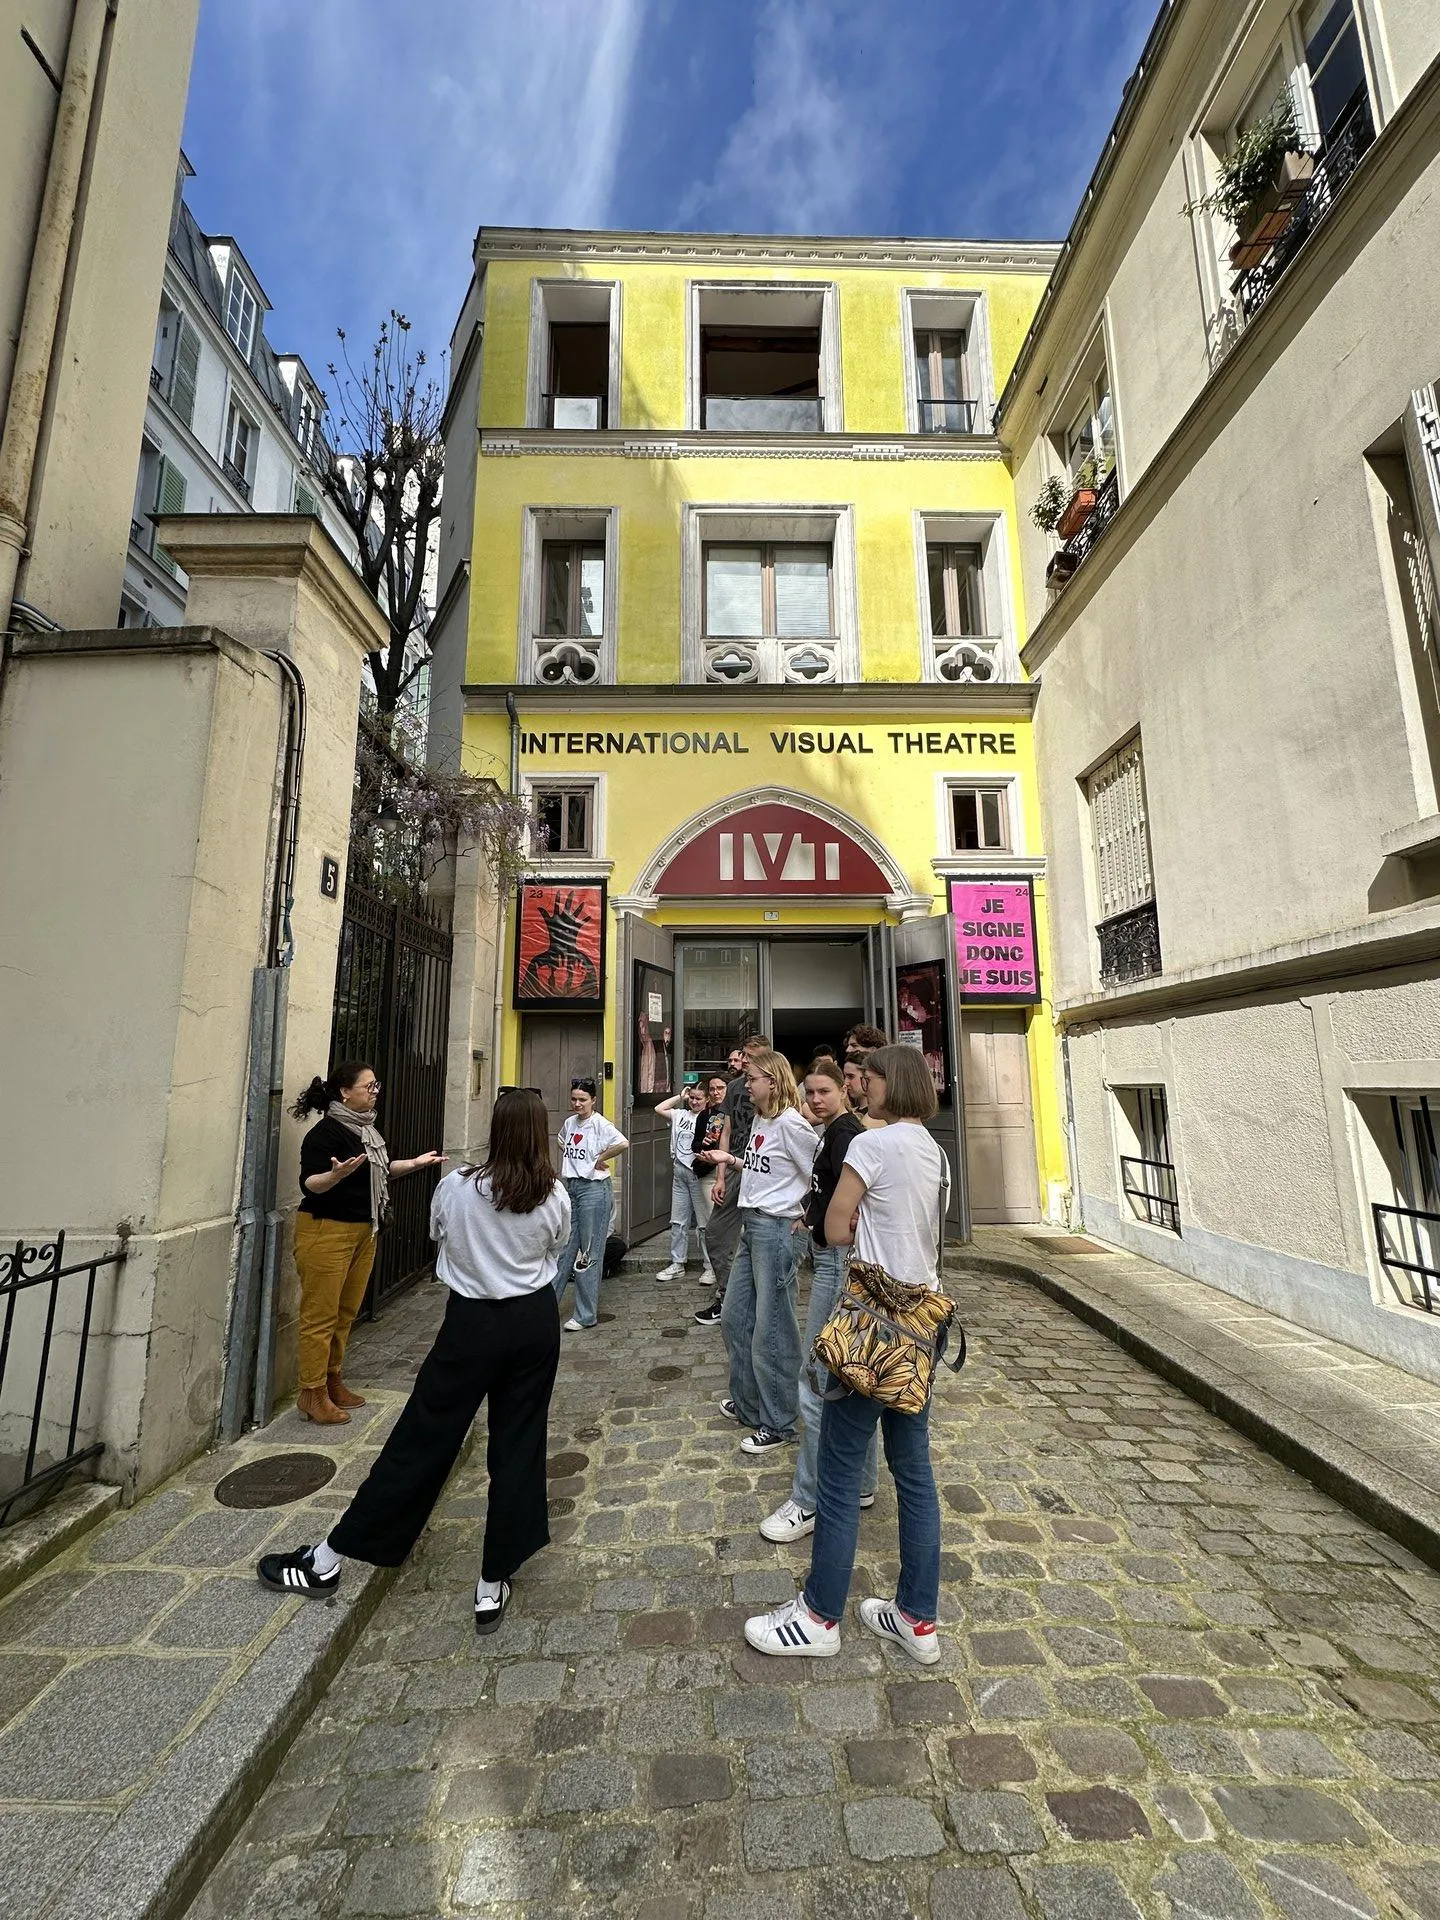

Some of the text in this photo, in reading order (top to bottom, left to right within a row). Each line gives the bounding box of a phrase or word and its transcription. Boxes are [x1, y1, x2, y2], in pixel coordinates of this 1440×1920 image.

[521, 732, 1017, 754] INTERNATIONAL VISUAL THEATRE
[326, 863, 336, 892] 5
[529, 889, 544, 899] 23
[1015, 888, 1029, 896] 24
[981, 899, 1005, 913] JE
[963, 922, 1025, 937] SIGNE
[967, 946, 1023, 961] DONC
[959, 969, 1033, 985] JE SUIS
[567, 1133, 574, 1145] I
[747, 1134, 755, 1151] I
